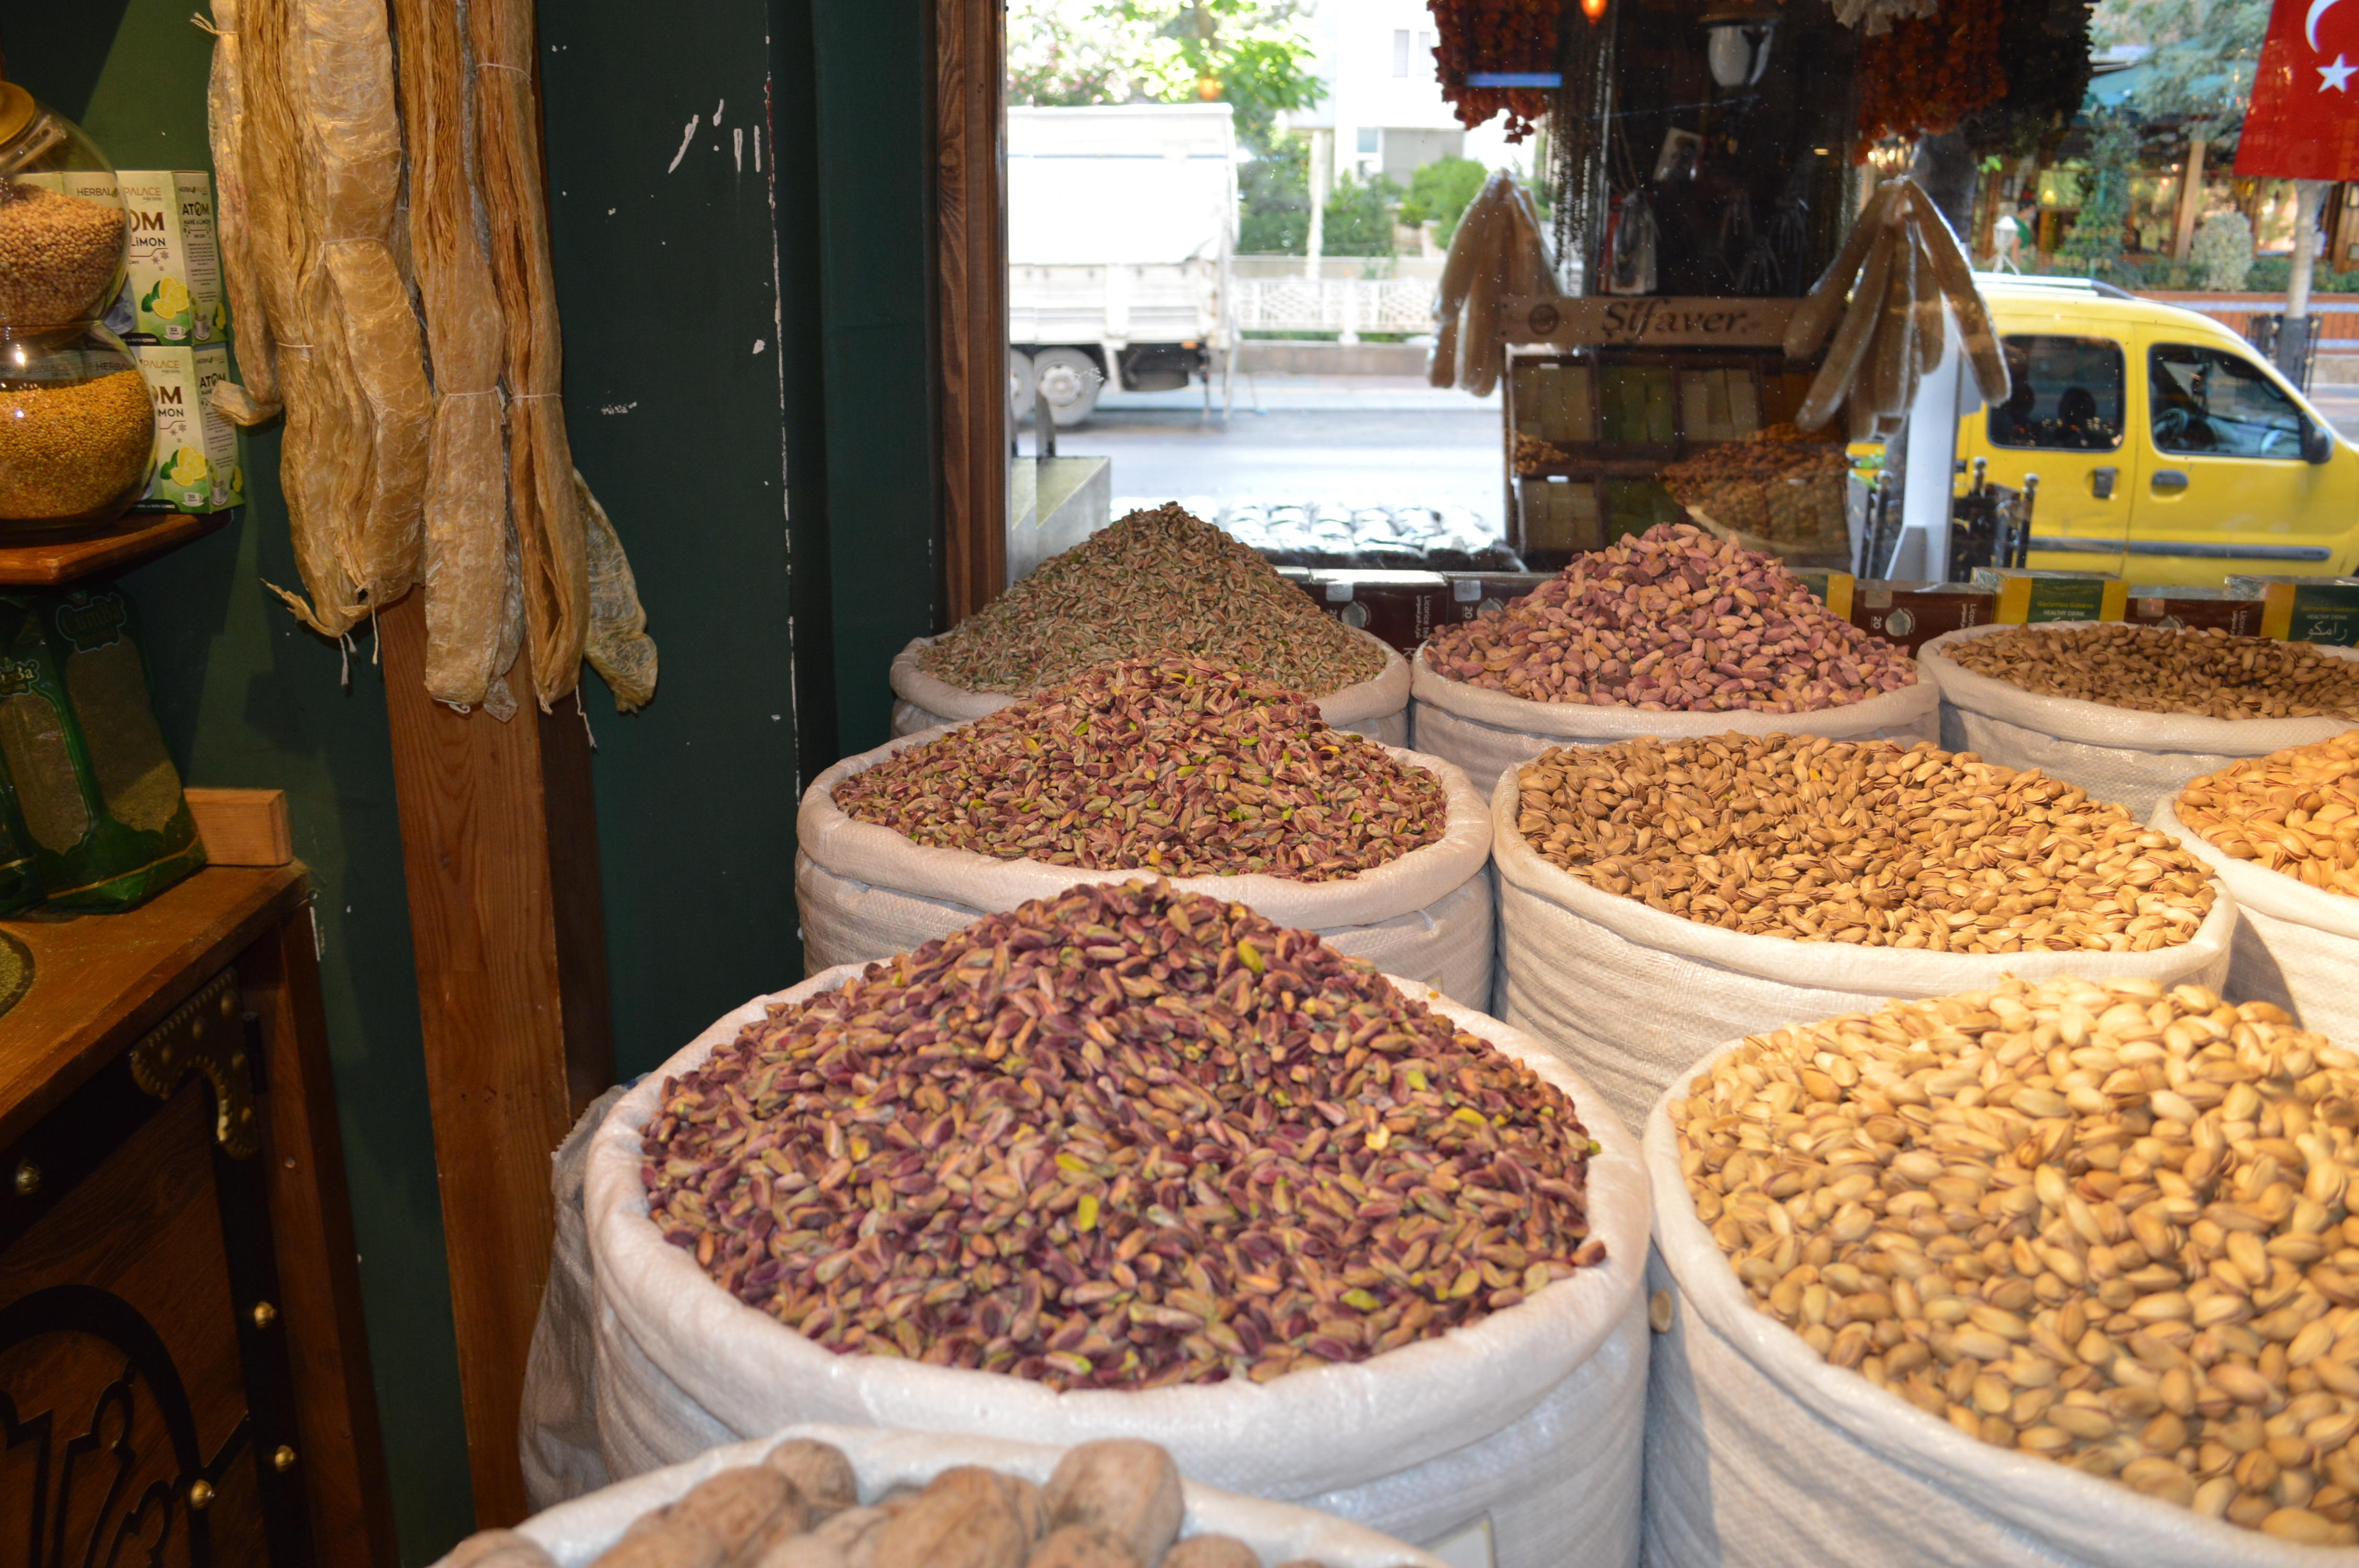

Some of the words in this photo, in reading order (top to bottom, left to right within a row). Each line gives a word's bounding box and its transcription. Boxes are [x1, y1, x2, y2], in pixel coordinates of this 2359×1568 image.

[76, 188, 112, 197] HERBAL
[124, 187, 162, 197] PALACE
[182, 202, 210, 216] ATOM
[130, 209, 165, 232] OM
[143, 360, 180, 369] PALACE
[158, 409, 184, 417] MON
[1423, 595, 1431, 627] Licorice
[1464, 606, 1473, 619] 20
[1873, 616, 1882, 630] 20
